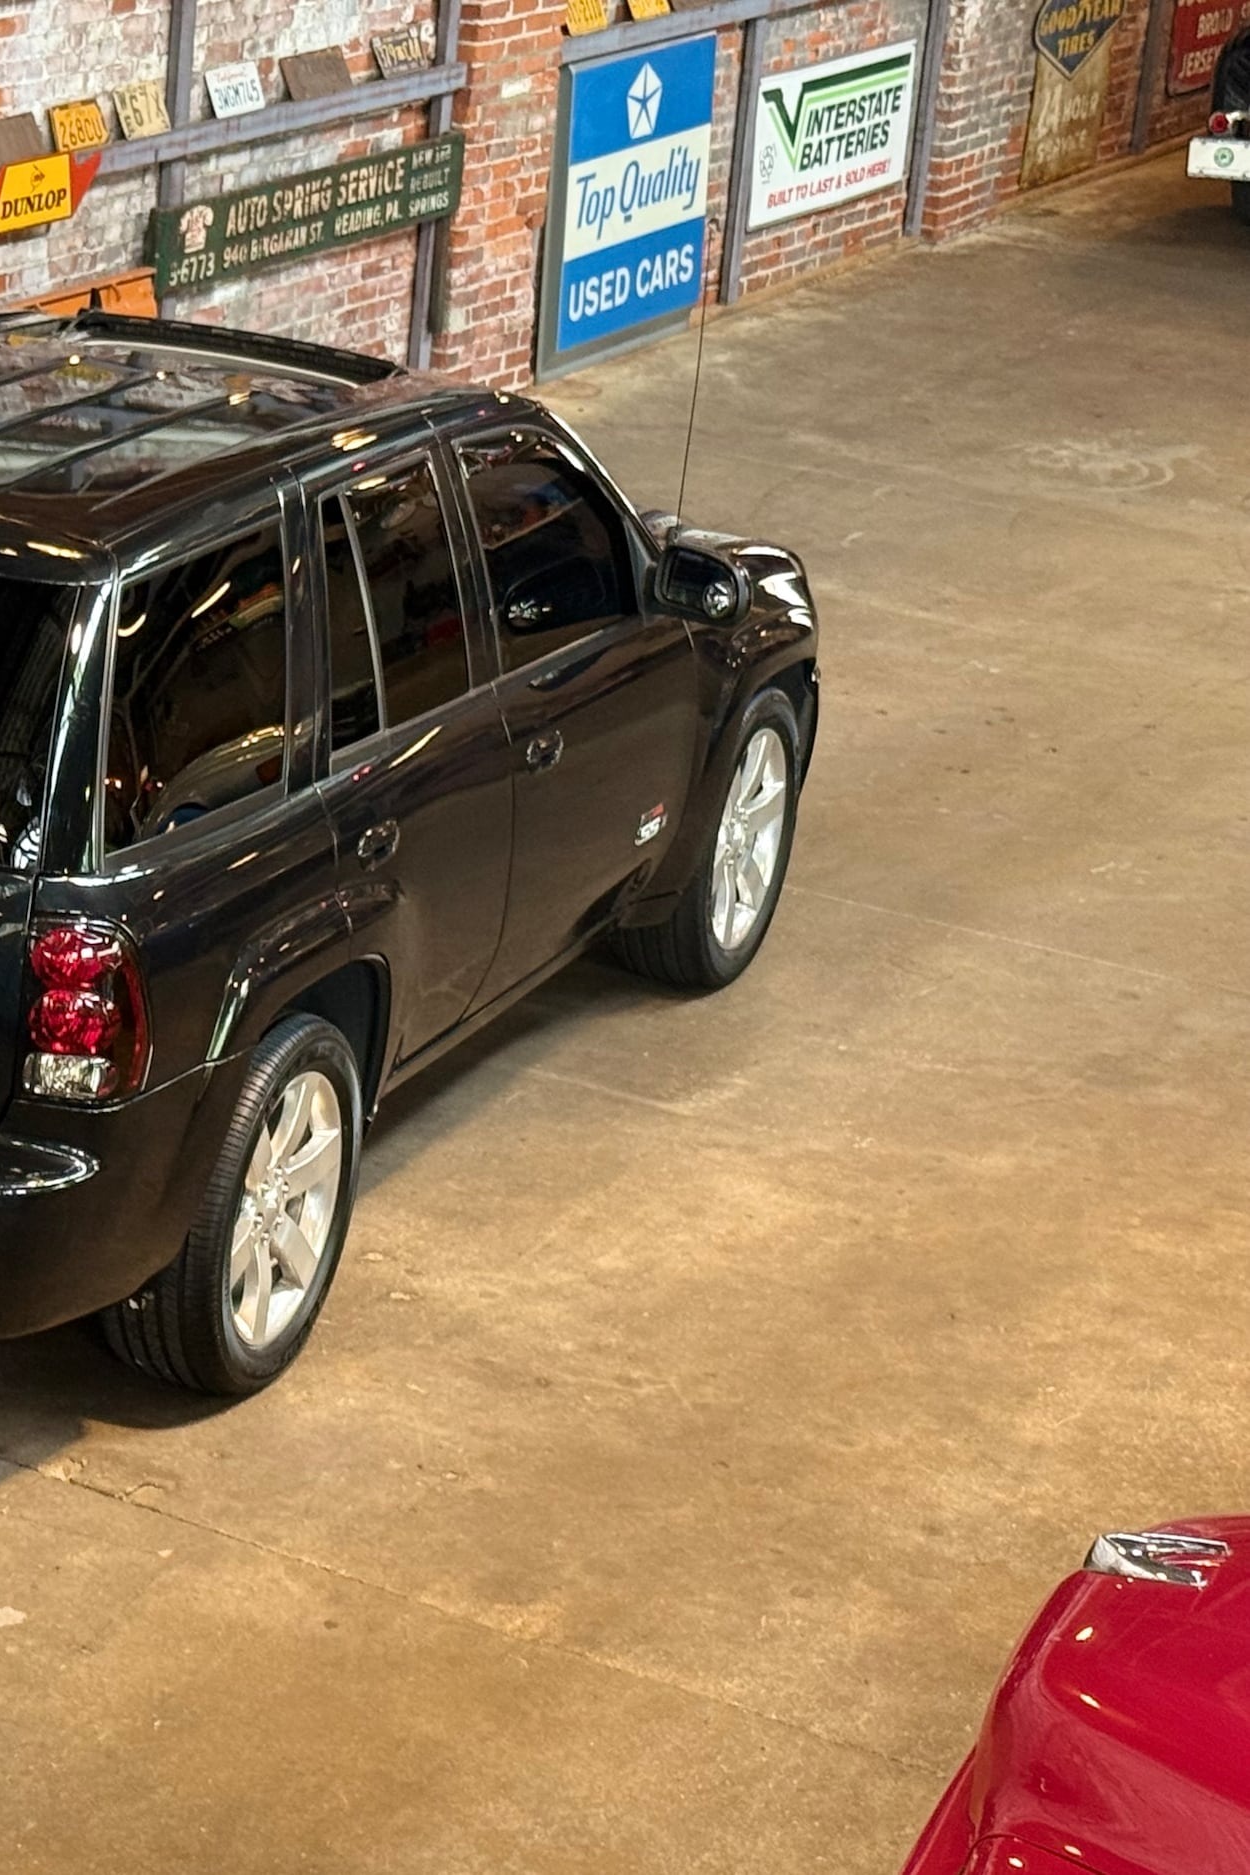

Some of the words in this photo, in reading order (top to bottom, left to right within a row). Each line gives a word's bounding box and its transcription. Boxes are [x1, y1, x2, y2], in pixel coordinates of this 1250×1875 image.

[1057, 29, 1095, 59] TIRES
[805, 85, 903, 139] INTERSTATE
[798, 120, 891, 172] BATTERIES
[0, 187, 67, 220] DUNLOP
[225, 194, 268, 238] AUTO
[271, 176, 333, 223] SPRING
[336, 157, 406, 206] SERVICE
[409, 168, 450, 194] REBUILT
[577, 172, 616, 240] Top
[620, 145, 701, 224] Quality
[767, 188, 794, 208] BUILT
[796, 183, 808, 200] TO
[809, 177, 835, 196] LAST
[844, 167, 866, 186] SOLD
[409, 192, 450, 218] SPRINGS
[568, 267, 631, 322] USED
[635, 243, 695, 299] CARS
